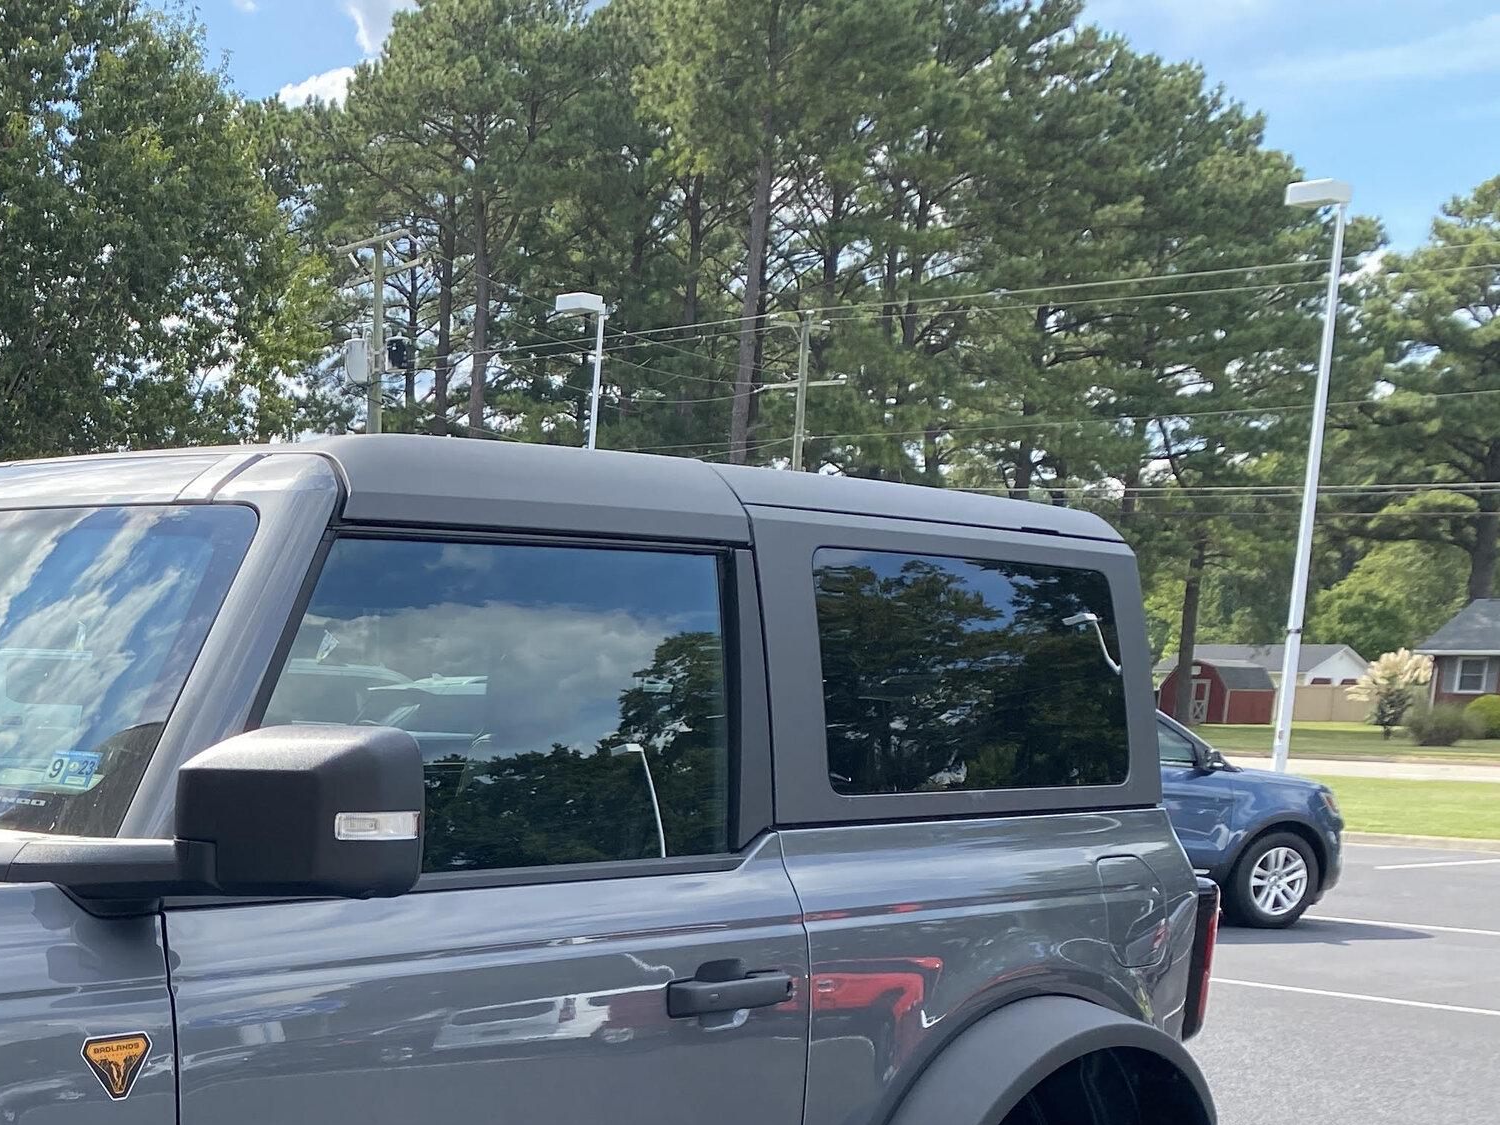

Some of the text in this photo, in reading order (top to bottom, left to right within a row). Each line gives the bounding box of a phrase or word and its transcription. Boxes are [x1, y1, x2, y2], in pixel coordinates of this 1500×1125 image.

[49, 759, 95, 778] 9 23
[93, 1043, 139, 1053] BADLANDS
